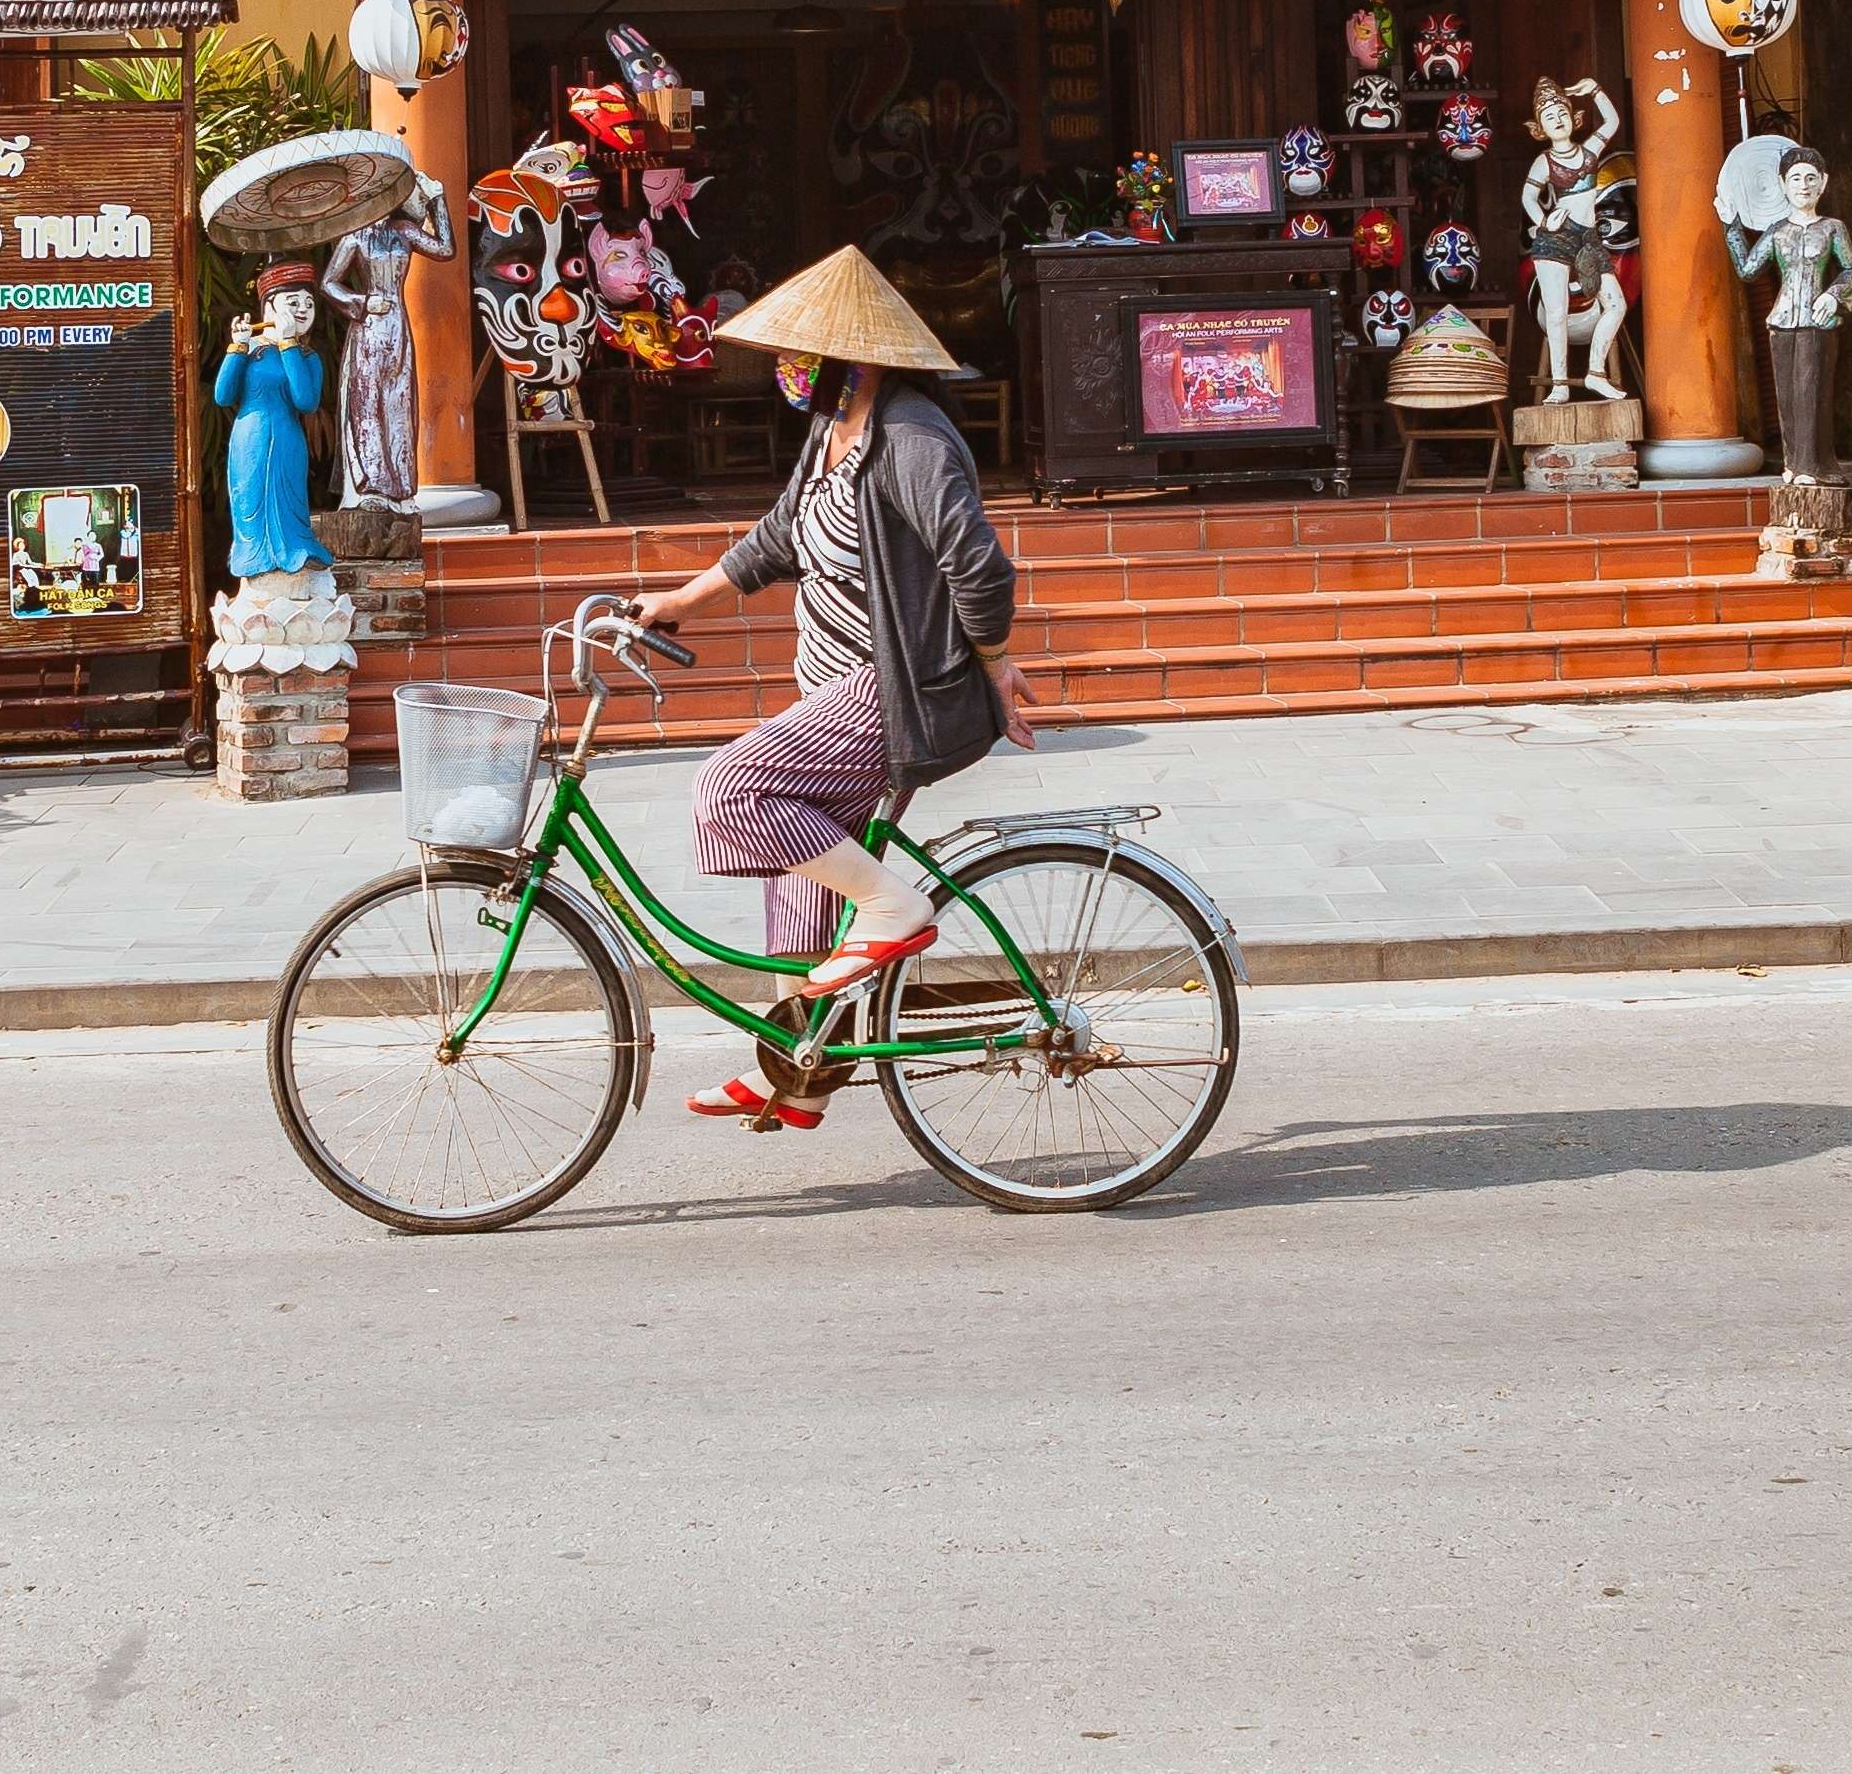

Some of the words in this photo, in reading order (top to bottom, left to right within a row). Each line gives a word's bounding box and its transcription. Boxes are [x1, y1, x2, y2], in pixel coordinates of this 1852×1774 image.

[1159, 323, 1174, 331] CA
[1216, 328, 1262, 336] PERFORMING
[23, 327, 55, 346] PM
[60, 325, 113, 344] EVERY
[97, 588, 115, 598] CA
[47, 602, 72, 611] FOLK
[73, 600, 108, 610] SONGS
